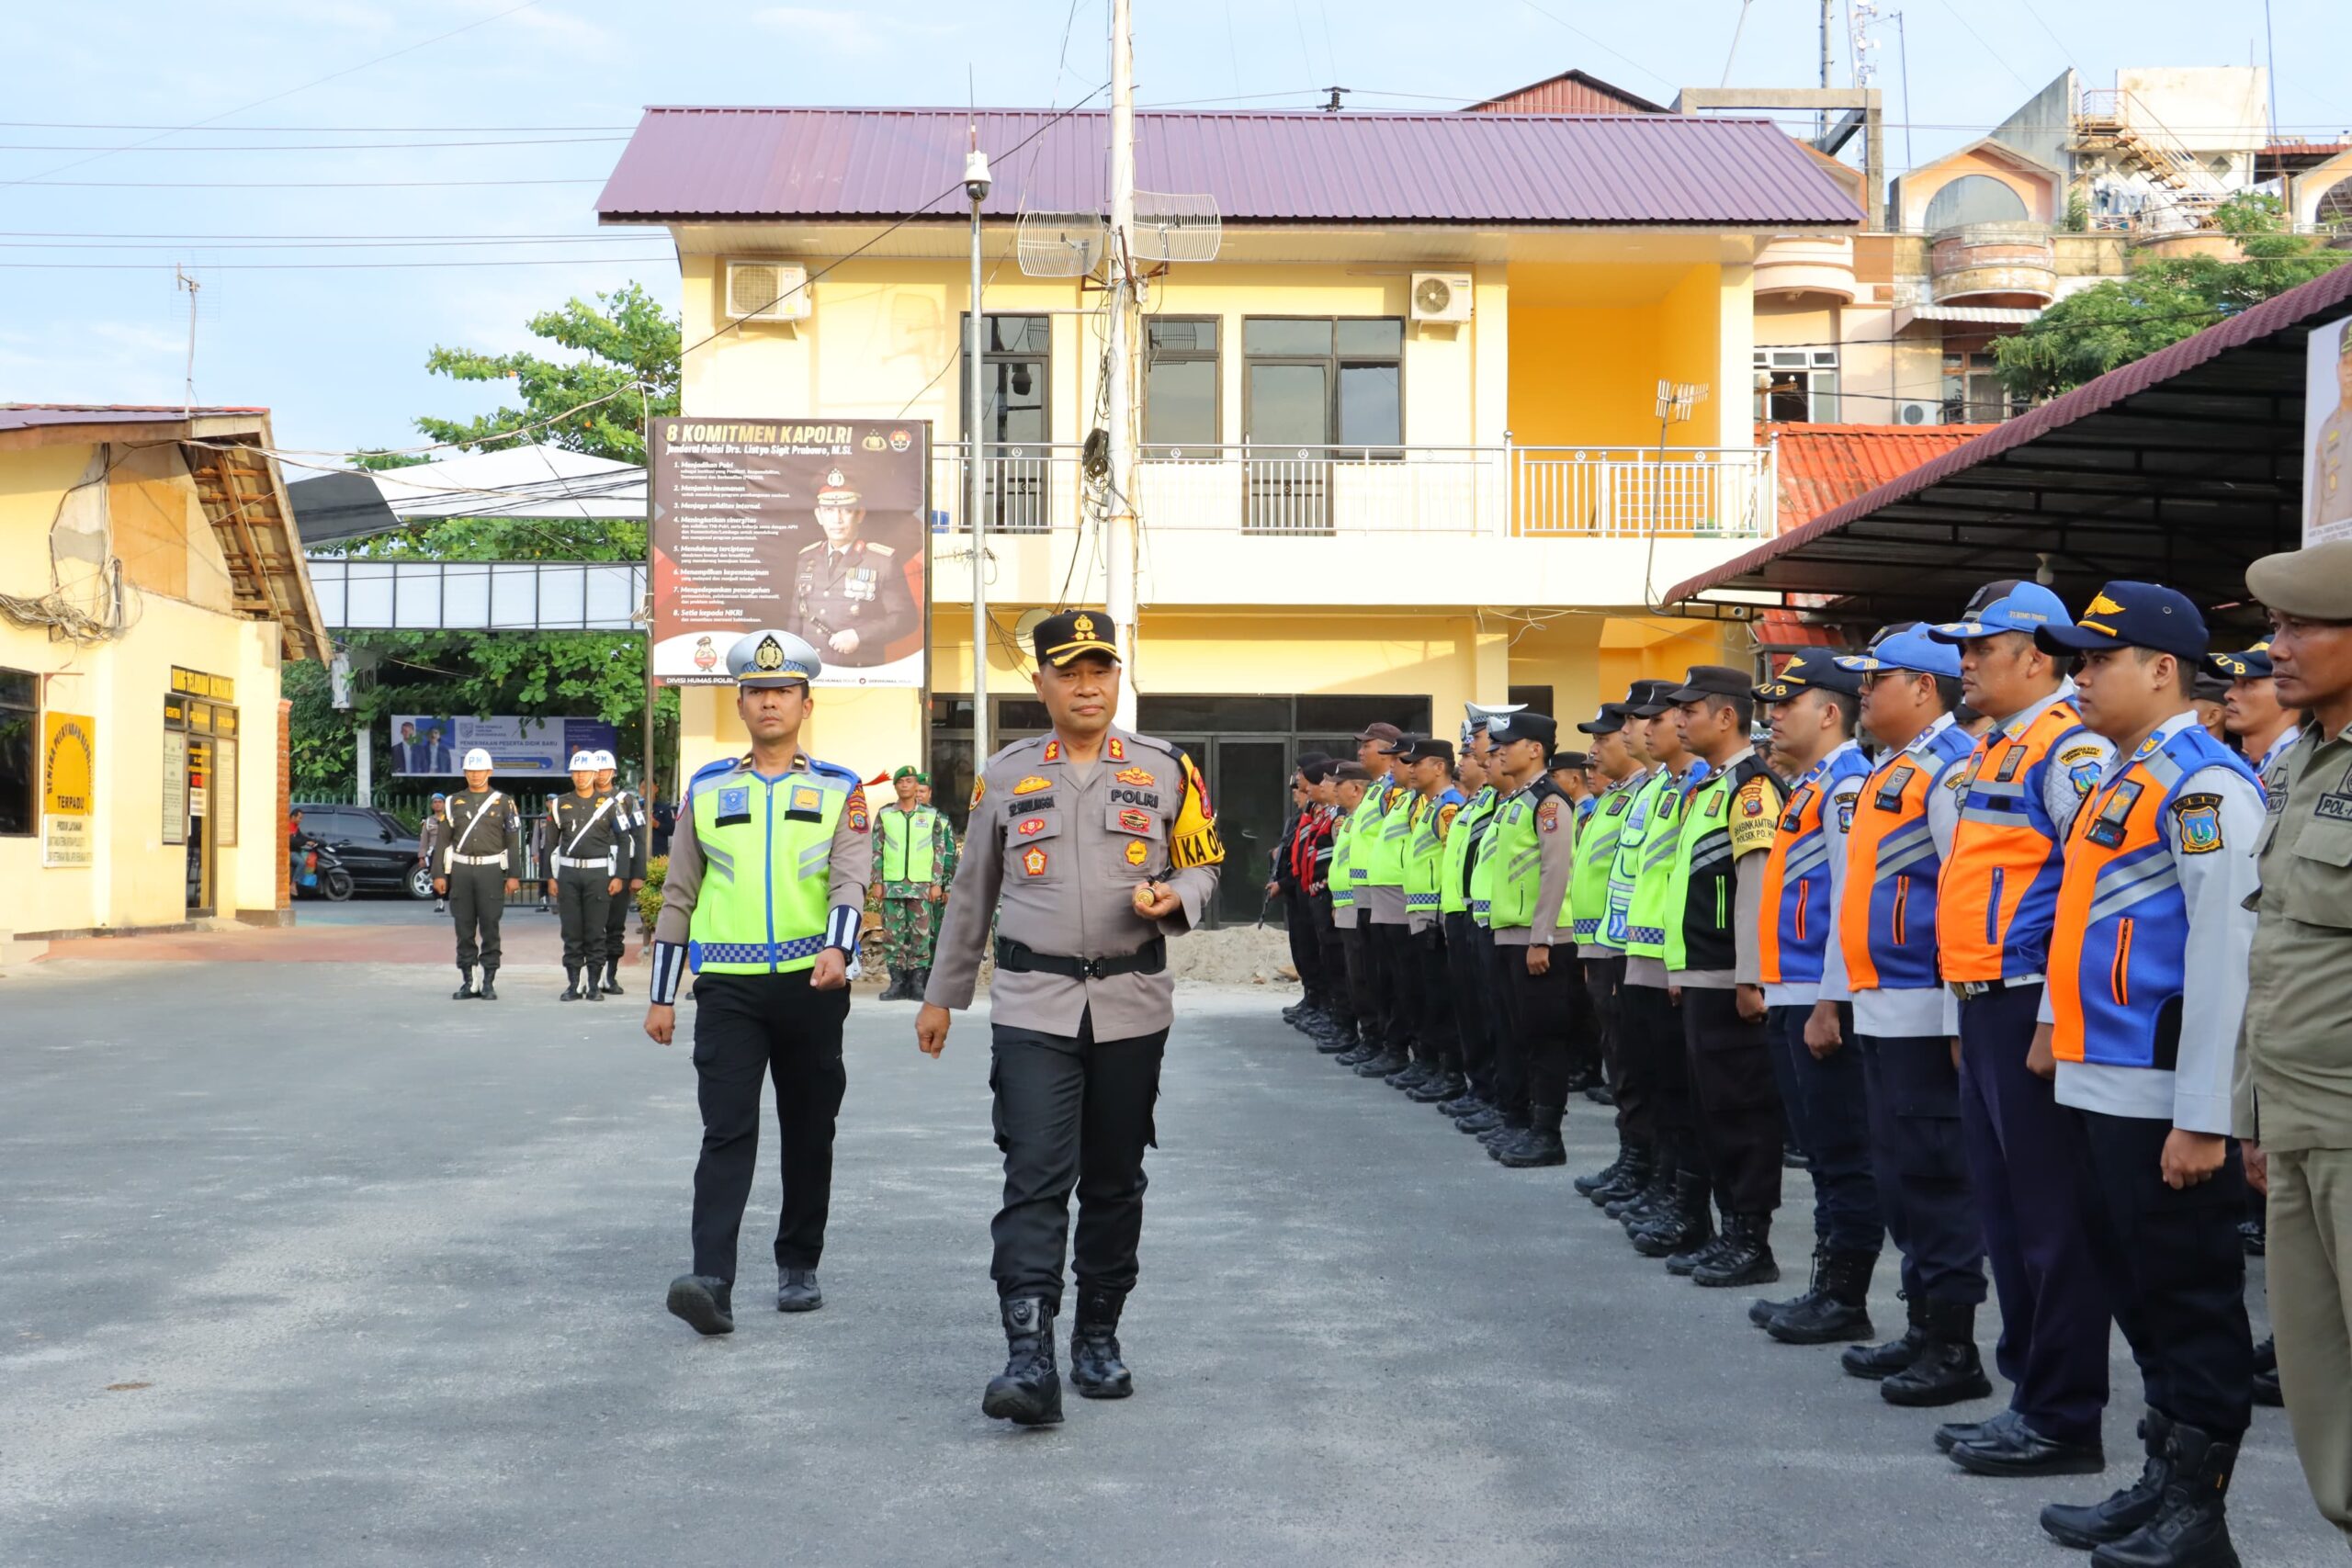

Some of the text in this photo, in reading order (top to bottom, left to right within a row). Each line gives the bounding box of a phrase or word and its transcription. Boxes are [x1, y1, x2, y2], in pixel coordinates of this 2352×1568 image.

[666, 424, 854, 444] 8 KOMITMEN KAPOLRI
[666, 444, 700, 456] Jenderal
[701, 445, 724, 455] Polisi
[725, 445, 742, 455] Drs.
[744, 445, 769, 457] Listyo
[771, 445, 789, 457] Sigit
[681, 502, 708, 511] Menjaga
[469, 755, 482, 765] PM
[573, 755, 588, 765] PM
[57, 795, 85, 809] TERPADU
[1111, 789, 1159, 808] POLRI
[1736, 831, 1756, 843] POLSEK
[1182, 834, 1208, 866] KA
